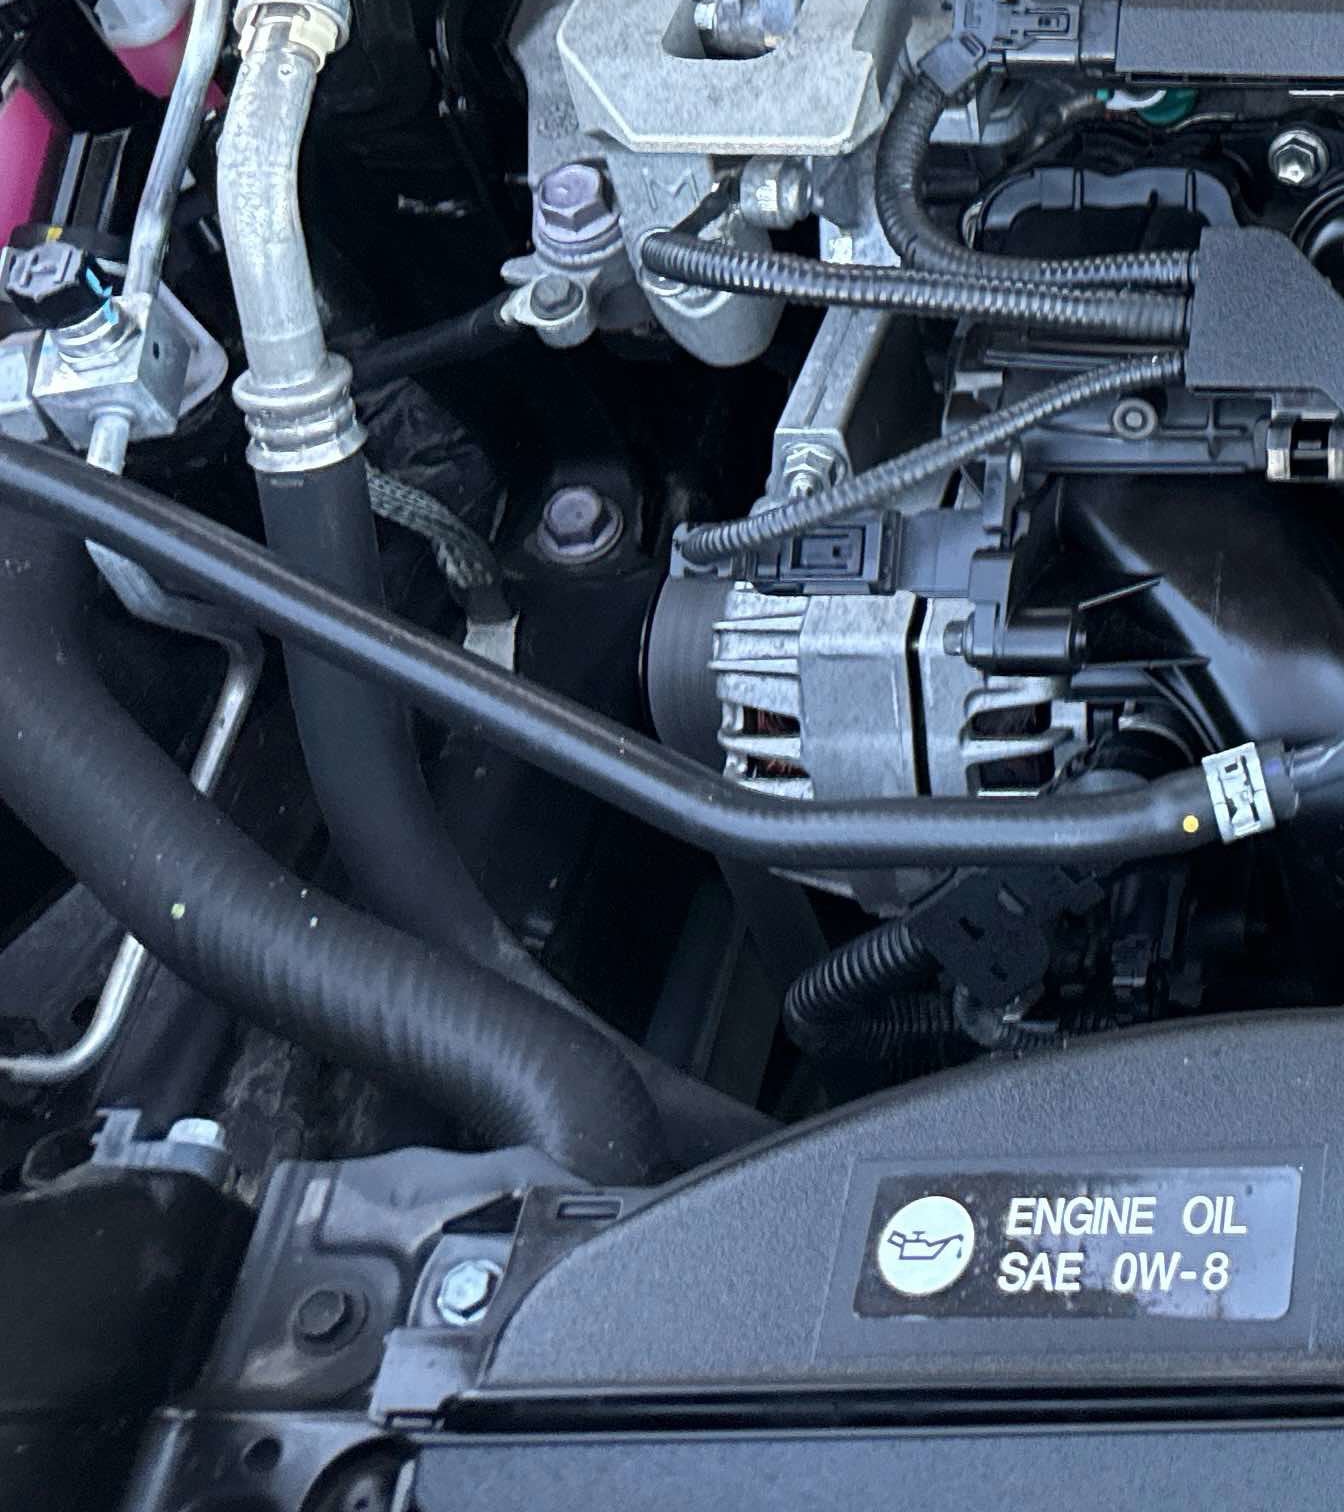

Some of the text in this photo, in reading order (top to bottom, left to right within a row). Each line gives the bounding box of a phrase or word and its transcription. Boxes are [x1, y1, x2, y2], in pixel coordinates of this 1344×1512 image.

[1006, 1196, 1247, 1236] ENGINE OIL
[997, 1251, 1229, 1292] SAE 0W-8
